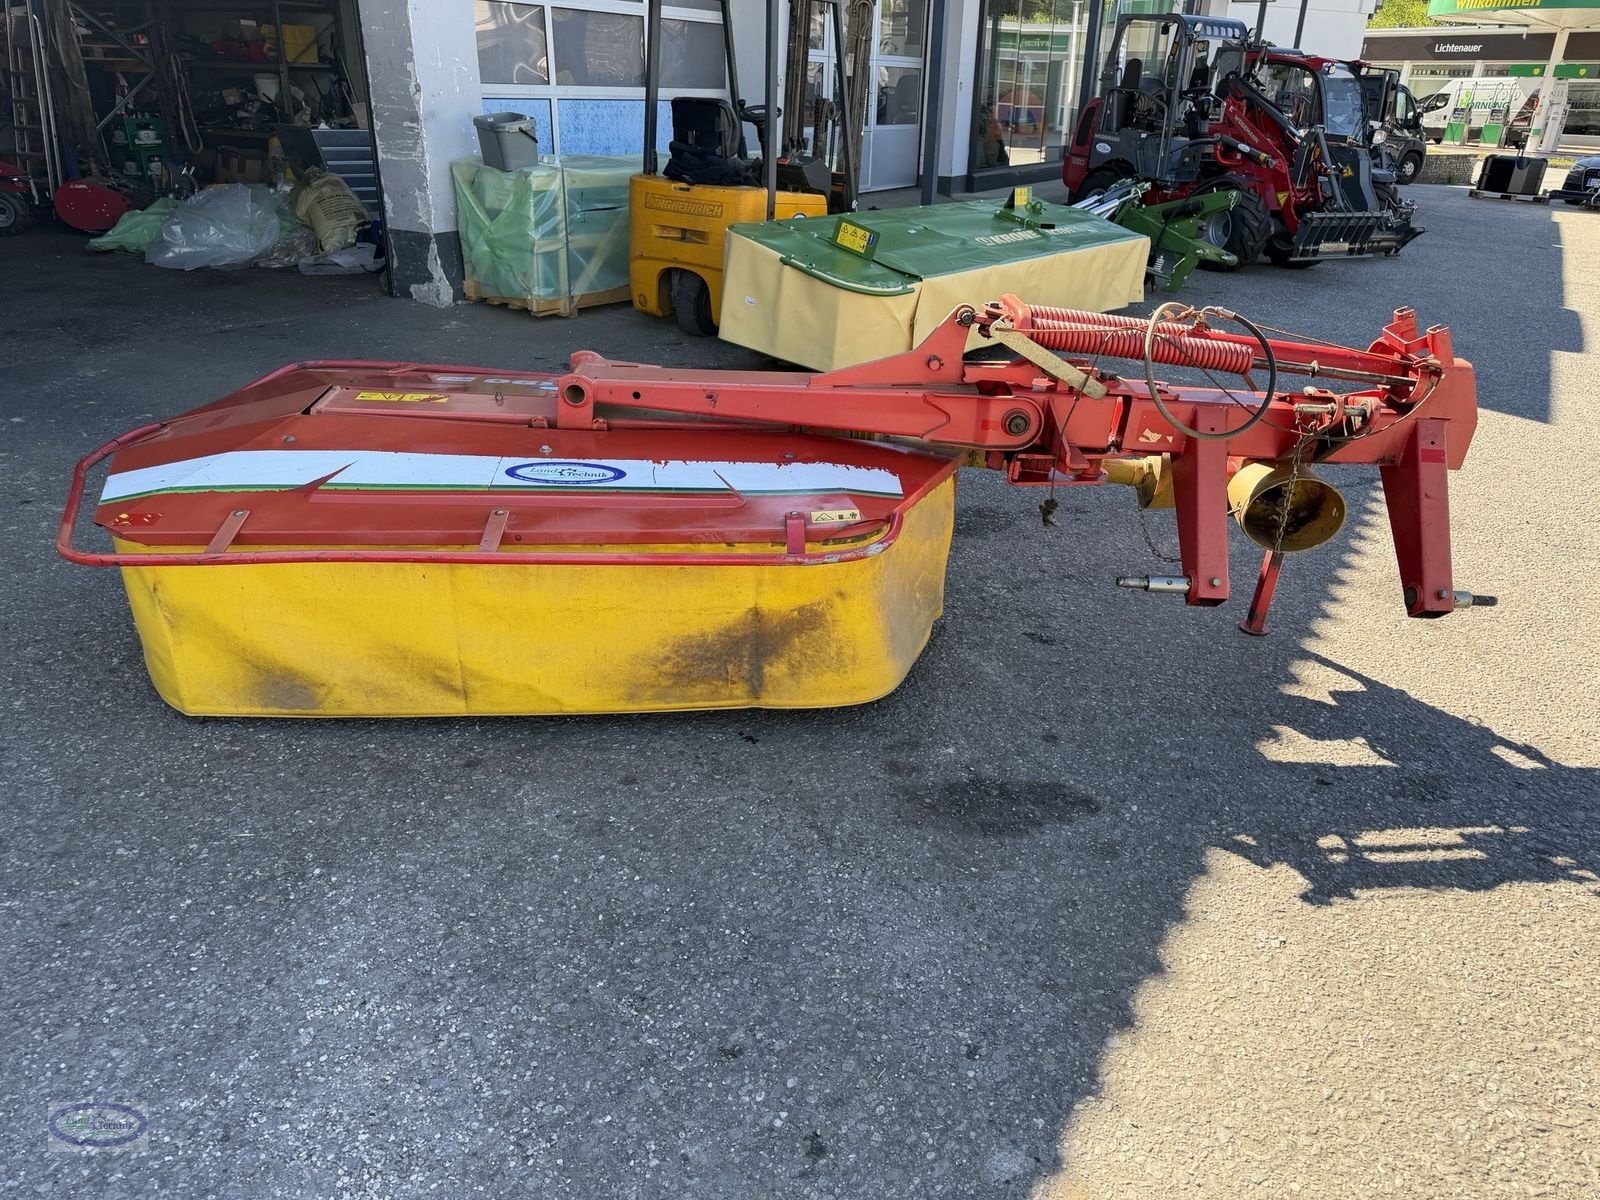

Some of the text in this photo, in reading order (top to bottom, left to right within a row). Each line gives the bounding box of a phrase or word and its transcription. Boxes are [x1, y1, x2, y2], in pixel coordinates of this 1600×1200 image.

[1456, 0, 1541, 10] Willkommen
[1434, 43, 1482, 53] Lichtenauer
[645, 193, 722, 217] JUNGHEINRICH
[989, 229, 1042, 245] KRONE
